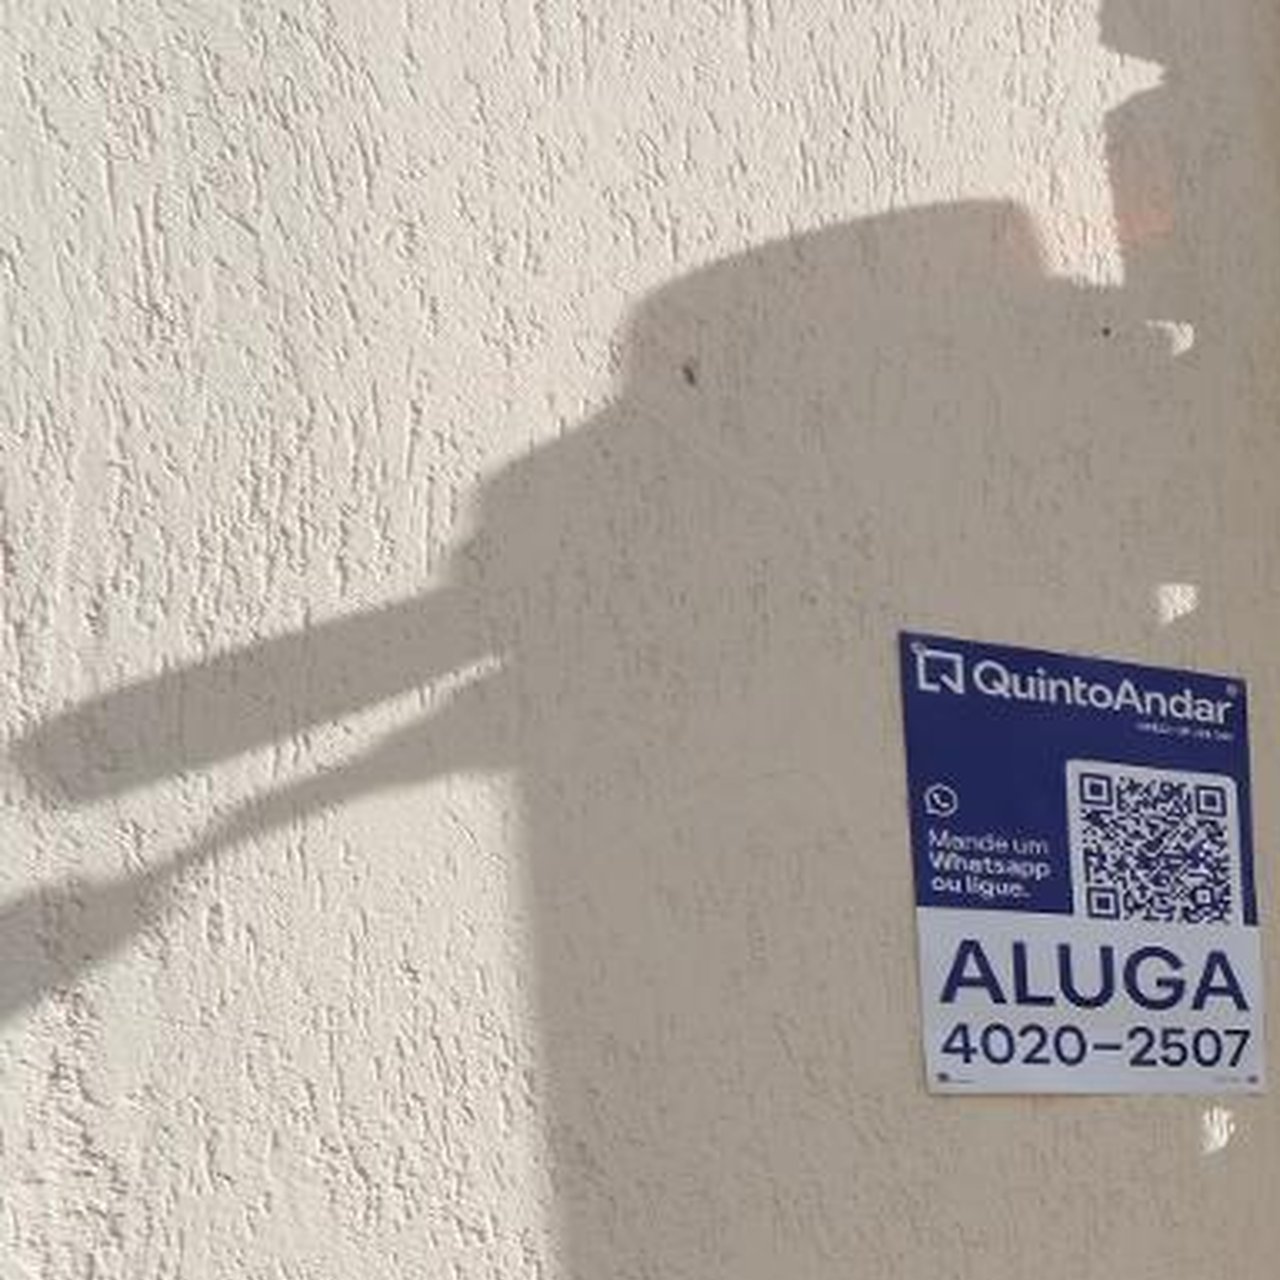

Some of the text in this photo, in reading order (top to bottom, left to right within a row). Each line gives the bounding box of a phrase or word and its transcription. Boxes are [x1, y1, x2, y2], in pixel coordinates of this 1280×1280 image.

[972, 659, 1234, 725] QuintoAndar
[928, 828, 1049, 855] Mande um
[928, 850, 1052, 881] Whatsapp
[931, 875, 962, 893] ou
[939, 939, 1251, 1012] ALUGA
[941, 1022, 1252, 1068] 4020-2507
